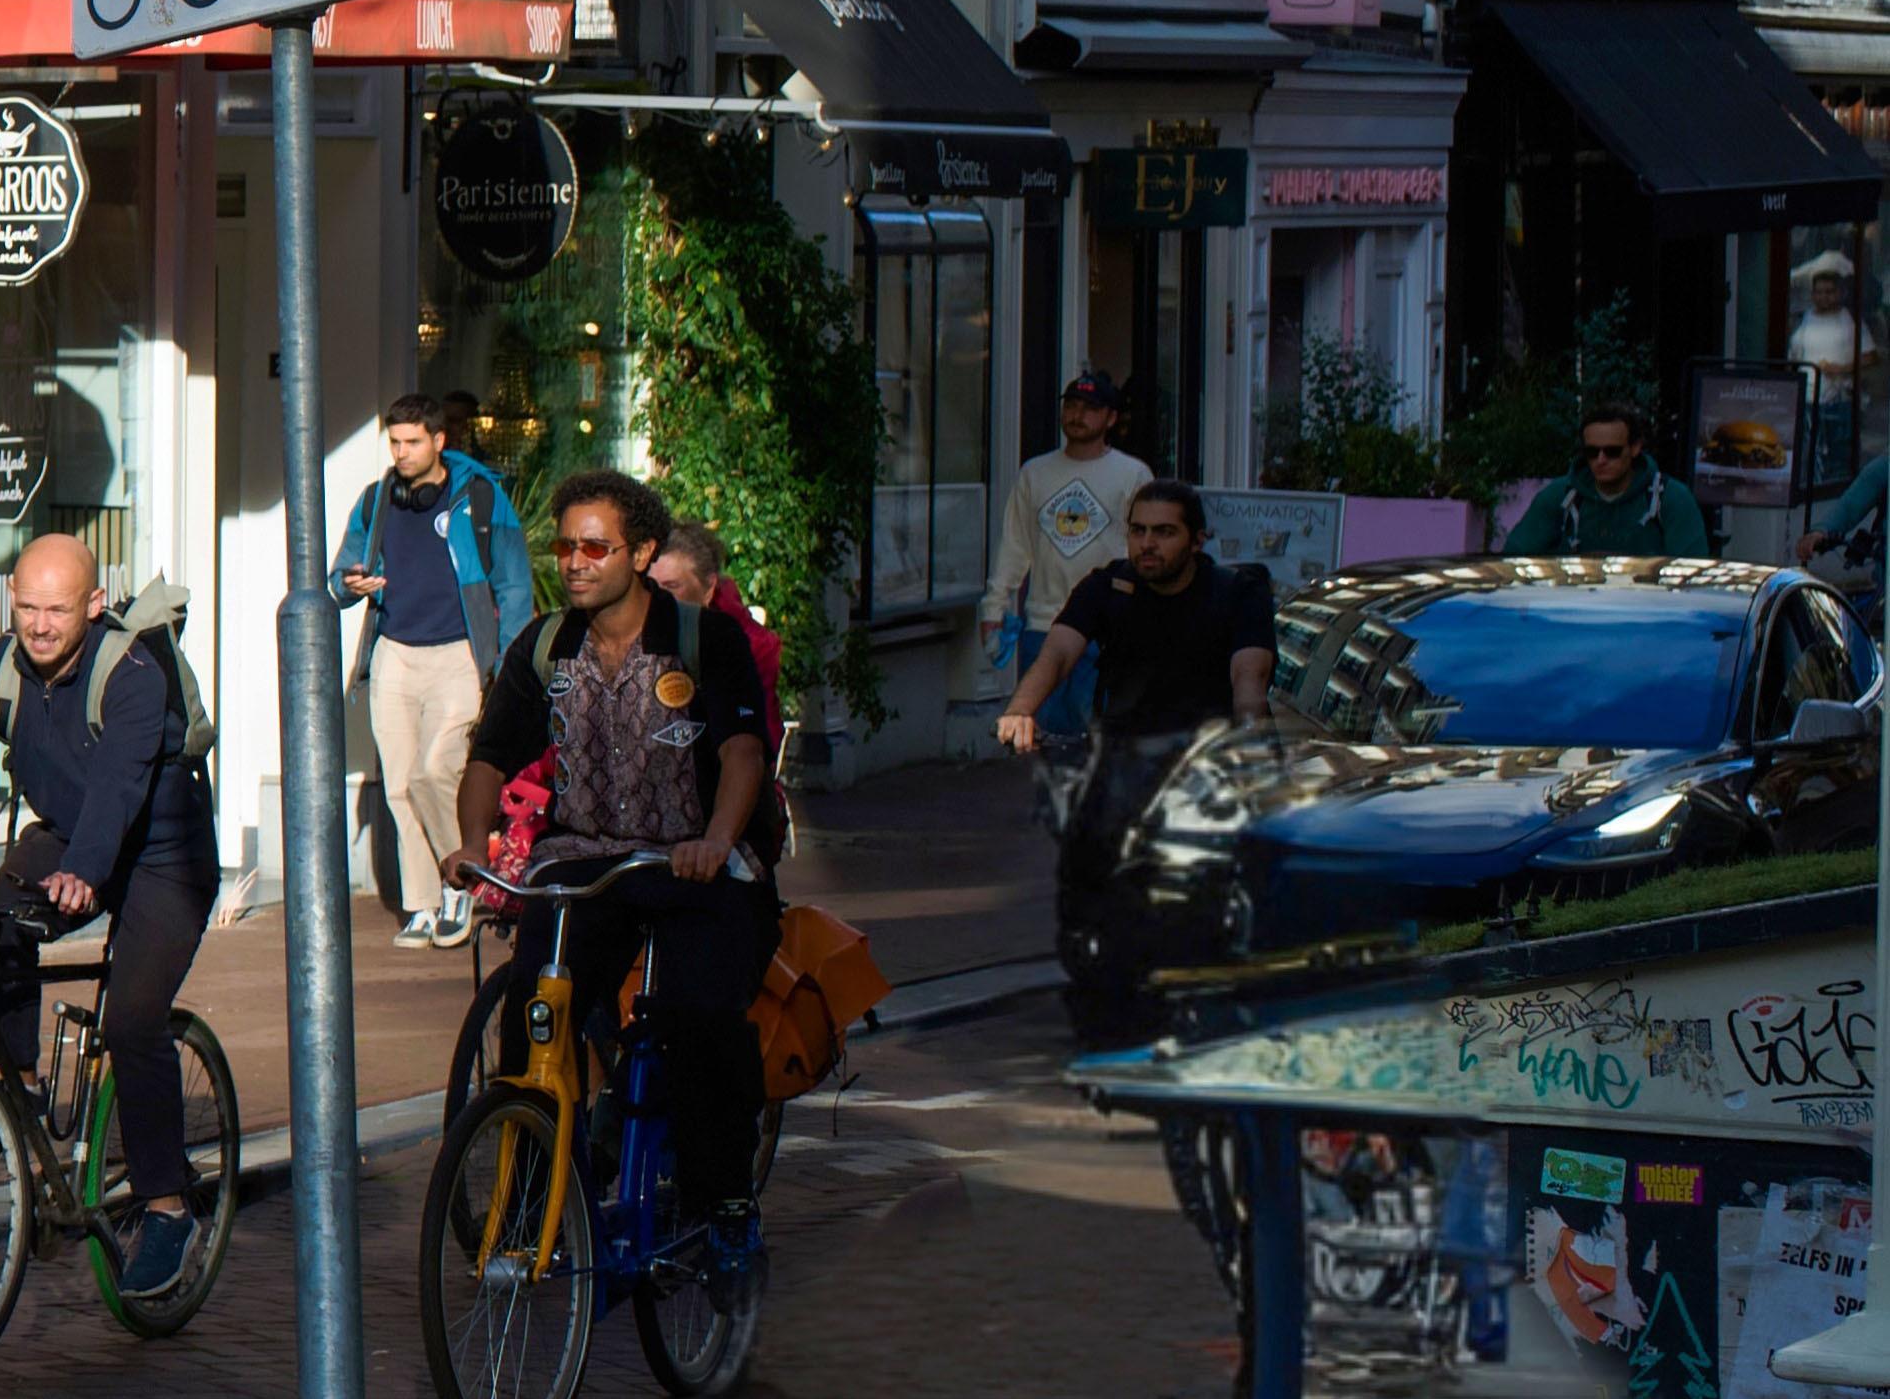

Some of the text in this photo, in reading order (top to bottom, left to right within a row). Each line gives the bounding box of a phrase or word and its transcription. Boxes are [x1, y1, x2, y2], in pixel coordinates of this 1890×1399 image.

[417, 0, 561, 55] LUNCH SOUPS
[437, 176, 573, 212] Parisienne
[1203, 498, 1327, 525] NOMINATION
[1638, 1165, 1700, 1184] mister
[1835, 1255, 1854, 1277] IN
